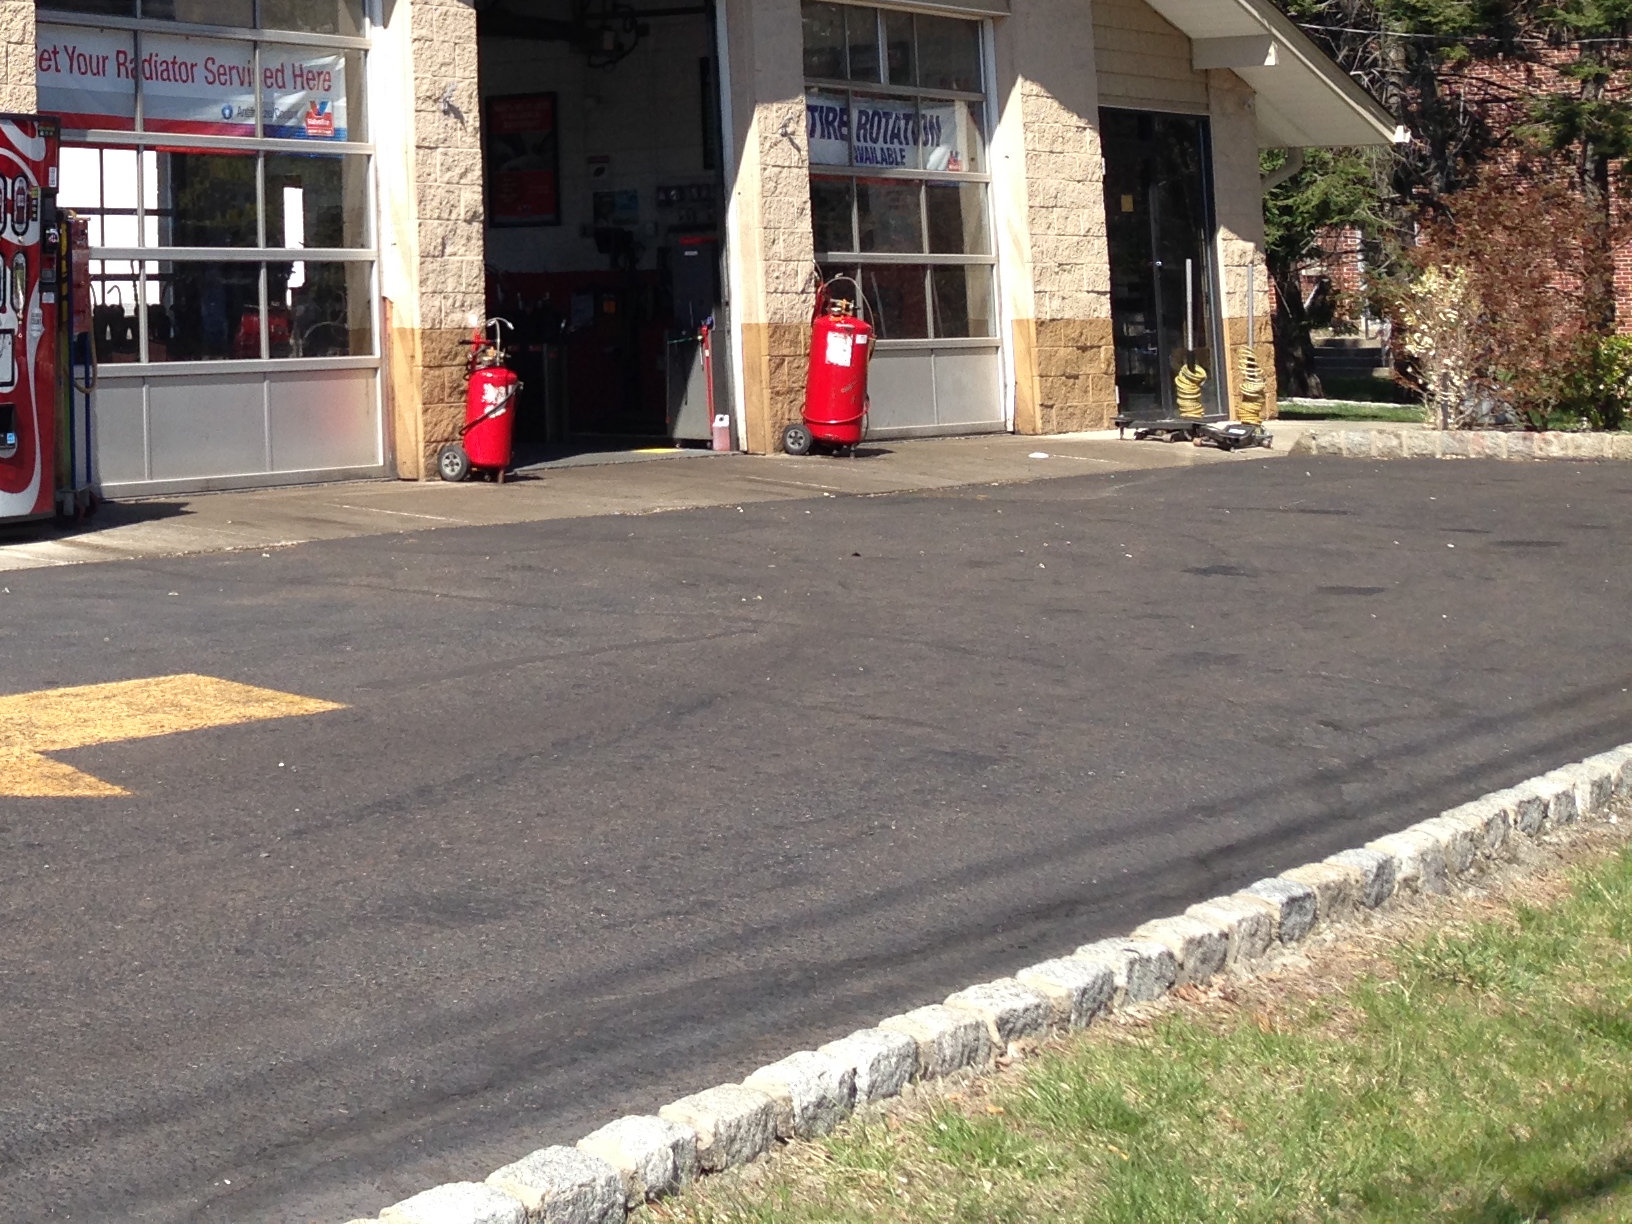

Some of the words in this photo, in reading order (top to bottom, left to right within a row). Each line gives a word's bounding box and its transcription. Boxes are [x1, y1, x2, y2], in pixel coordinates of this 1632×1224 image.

[35, 42, 62, 73] et
[63, 45, 109, 77] Your
[116, 49, 197, 84] Radiator
[204, 56, 287, 90] Servied
[292, 62, 332, 92] Here
[806, 104, 849, 142] TIRE
